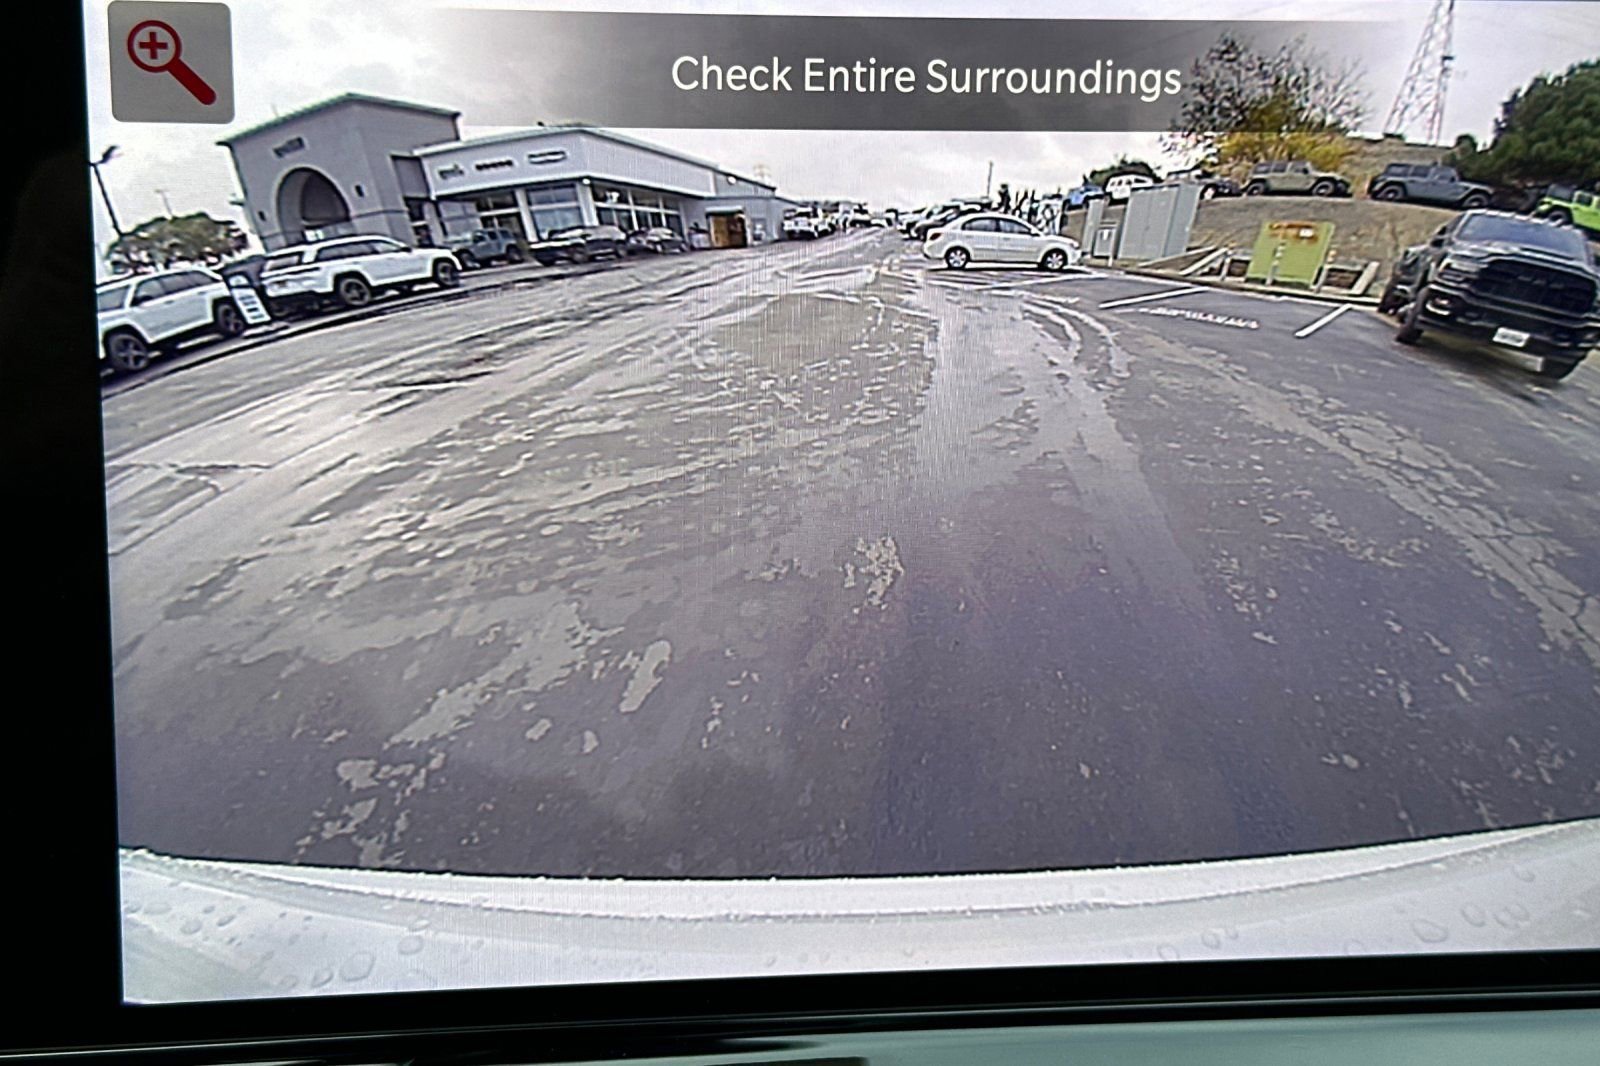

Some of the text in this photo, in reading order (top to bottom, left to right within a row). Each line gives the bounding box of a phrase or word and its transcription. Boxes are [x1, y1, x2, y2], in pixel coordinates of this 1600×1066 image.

[671, 55, 1183, 103] Check Entire Surroundings
